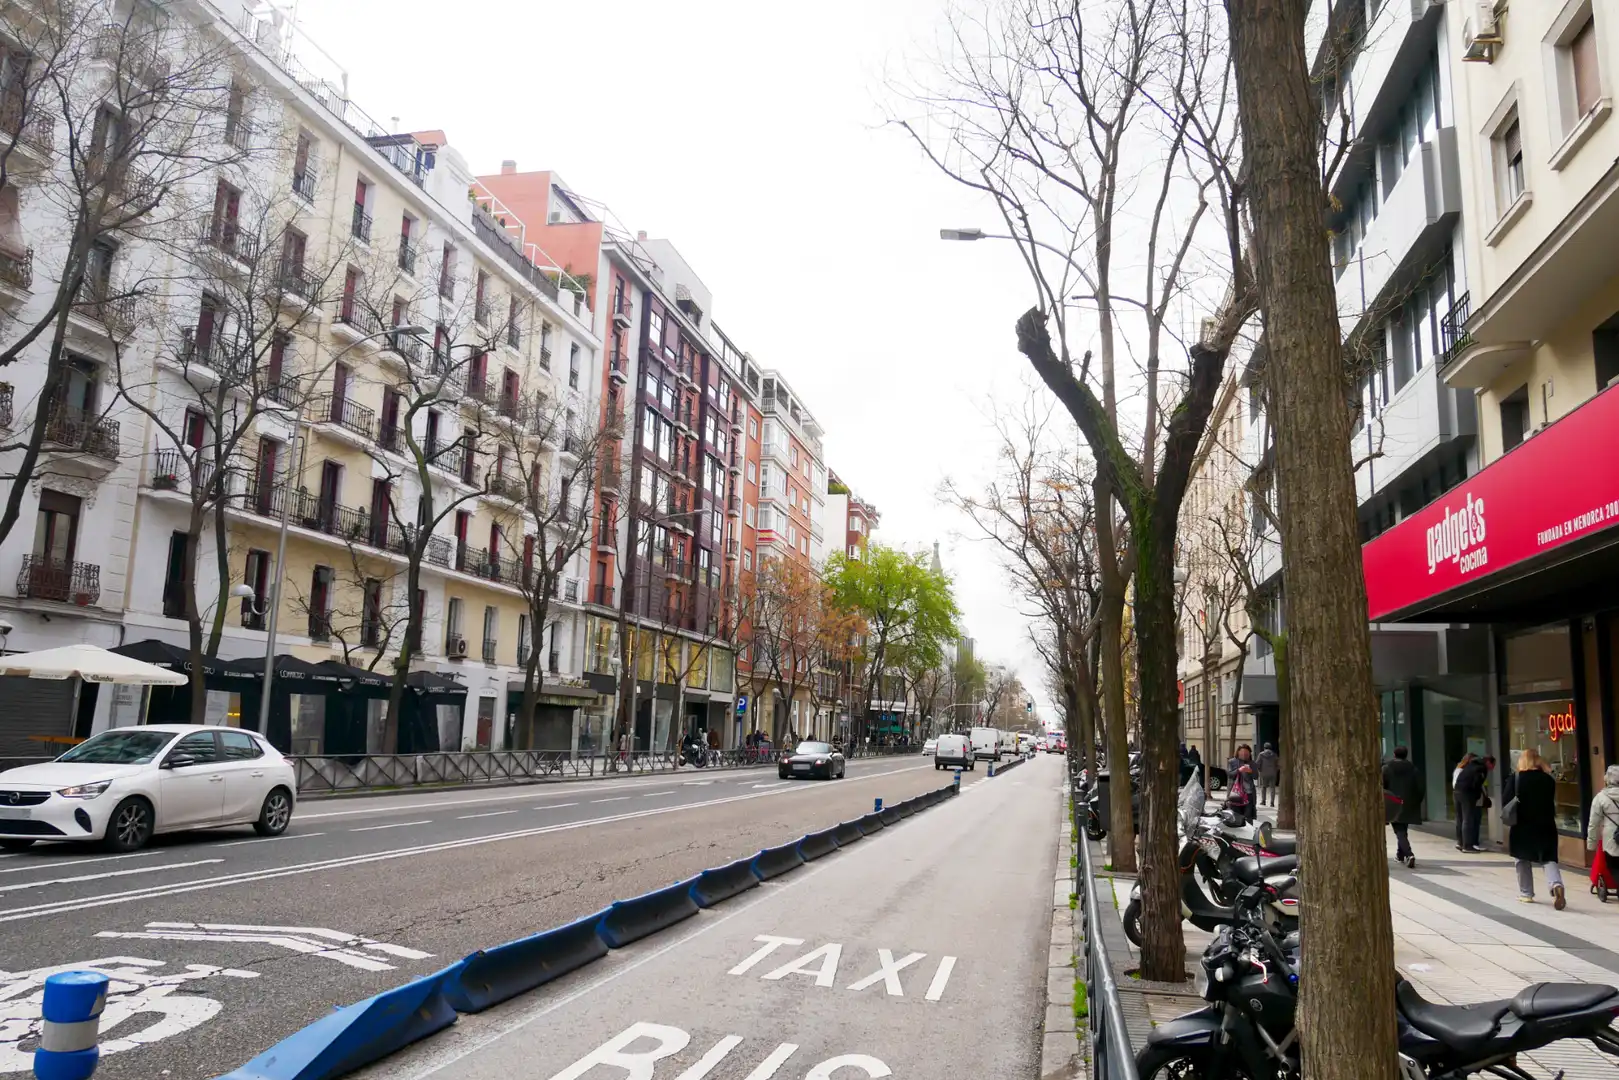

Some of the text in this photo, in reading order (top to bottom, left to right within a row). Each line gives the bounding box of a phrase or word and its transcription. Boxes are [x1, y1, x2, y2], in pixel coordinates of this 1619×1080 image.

[1426, 492, 1486, 575] gadgets
[1537, 499, 1619, 546] FUNDADA EN MENORCA 200
[1460, 546, 1488, 574] cocina
[727, 934, 958, 1001] TAXI
